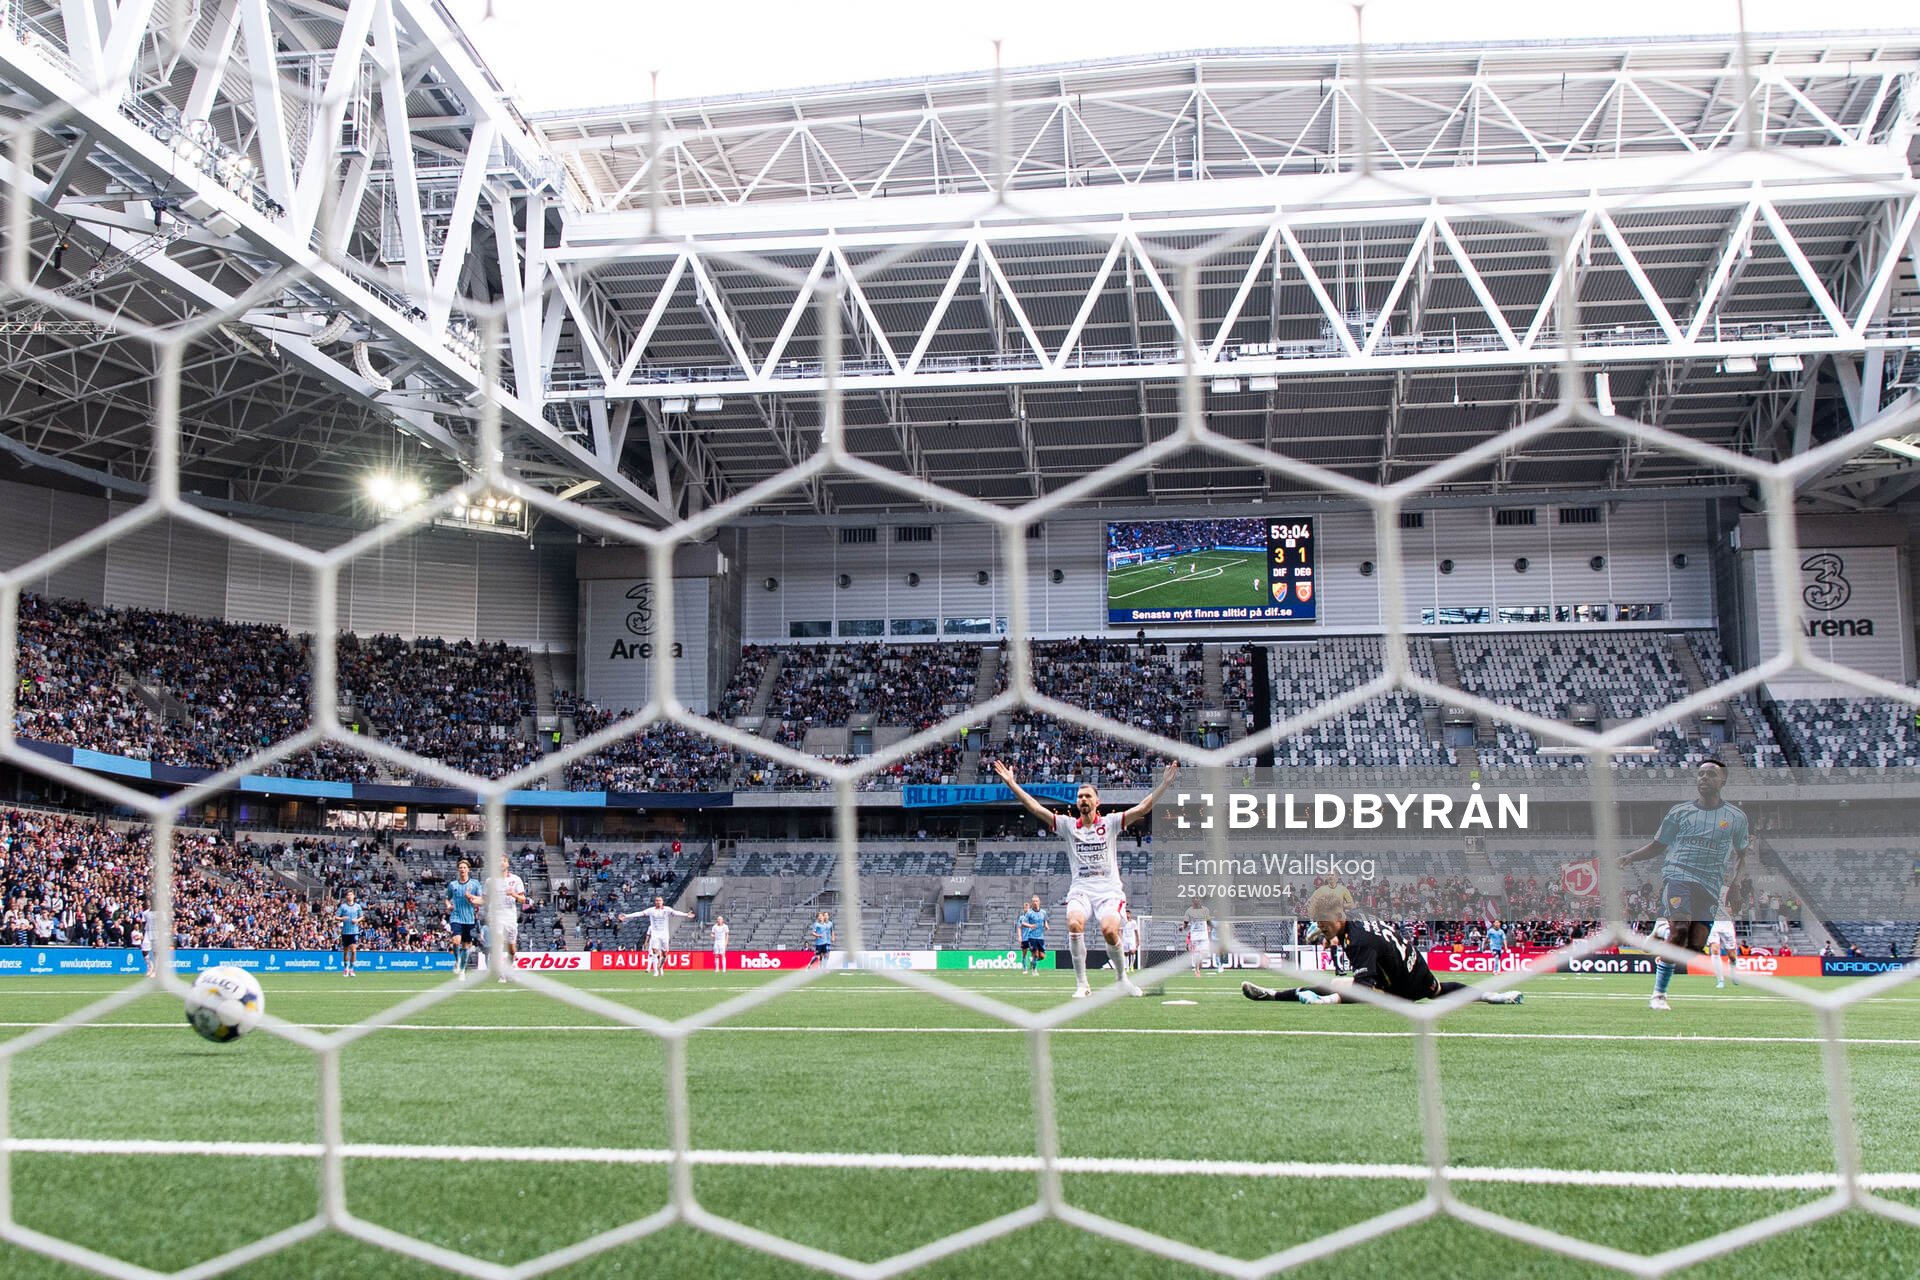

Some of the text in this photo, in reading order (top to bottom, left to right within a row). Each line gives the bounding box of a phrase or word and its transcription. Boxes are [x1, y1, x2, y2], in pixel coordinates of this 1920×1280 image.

[1271, 524, 1310, 539] 53:04
[1274, 547, 1306, 563] 3 1
[1273, 567, 1312, 577] DIF DEG
[1132, 607, 1293, 621] Senaste nytt finns alltid på dif.se
[609, 638, 683, 660] Area
[906, 787, 948, 805] ALLA
[954, 787, 988, 801] TILL
[603, 954, 691, 967] BAUHUS
[740, 952, 781, 969] habo
[1569, 957, 1652, 972] beans in
